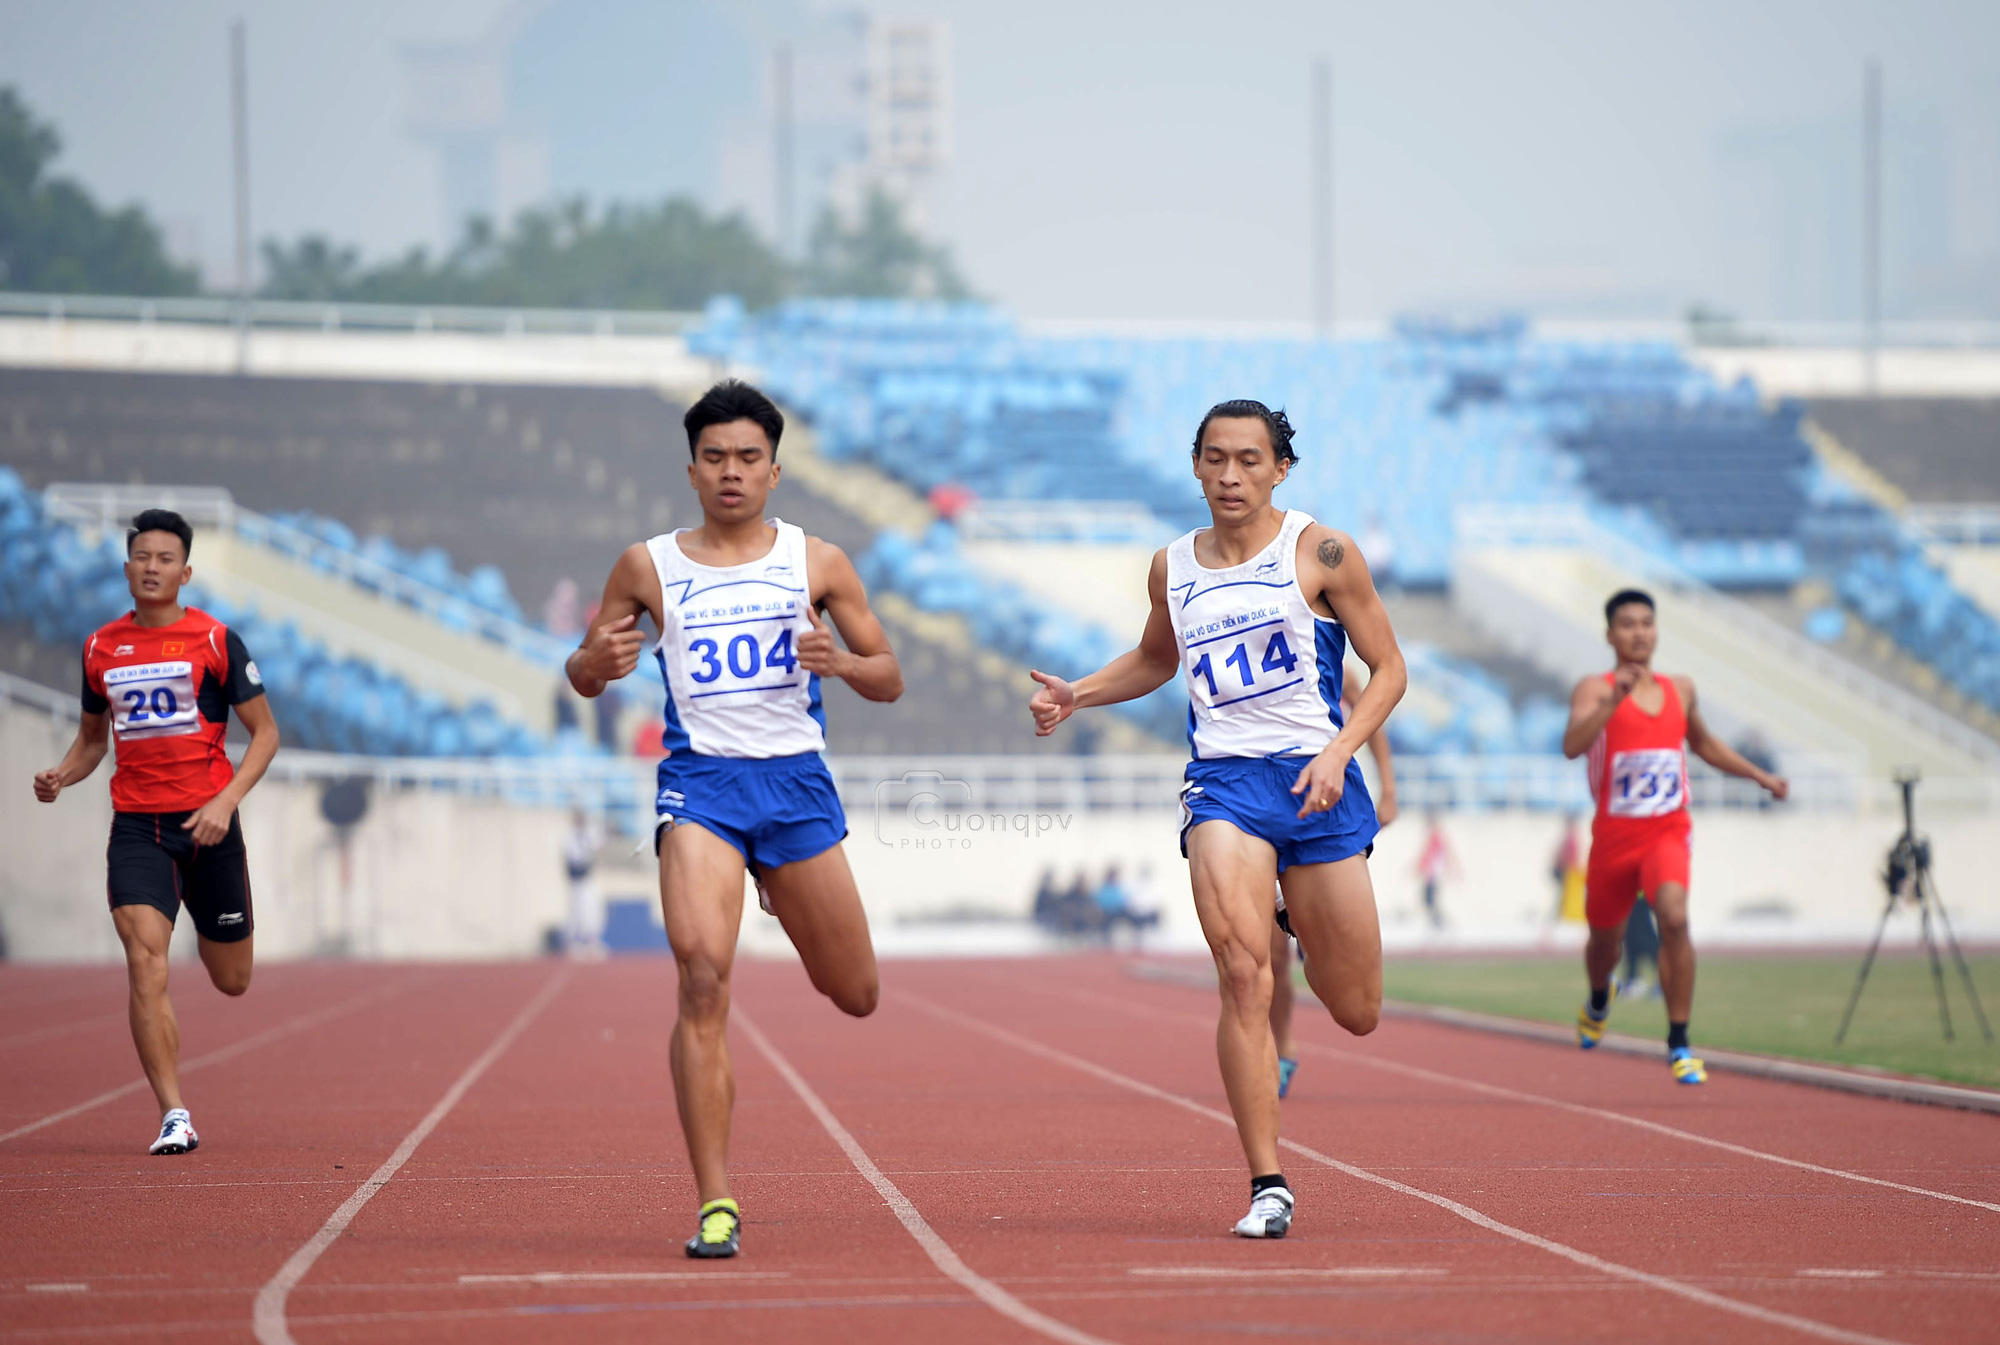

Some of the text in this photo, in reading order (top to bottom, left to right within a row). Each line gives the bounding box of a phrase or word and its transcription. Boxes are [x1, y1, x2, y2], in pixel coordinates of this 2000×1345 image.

[689, 628, 797, 683] 304
[1192, 630, 1298, 697] 114
[123, 686, 178, 722] 20
